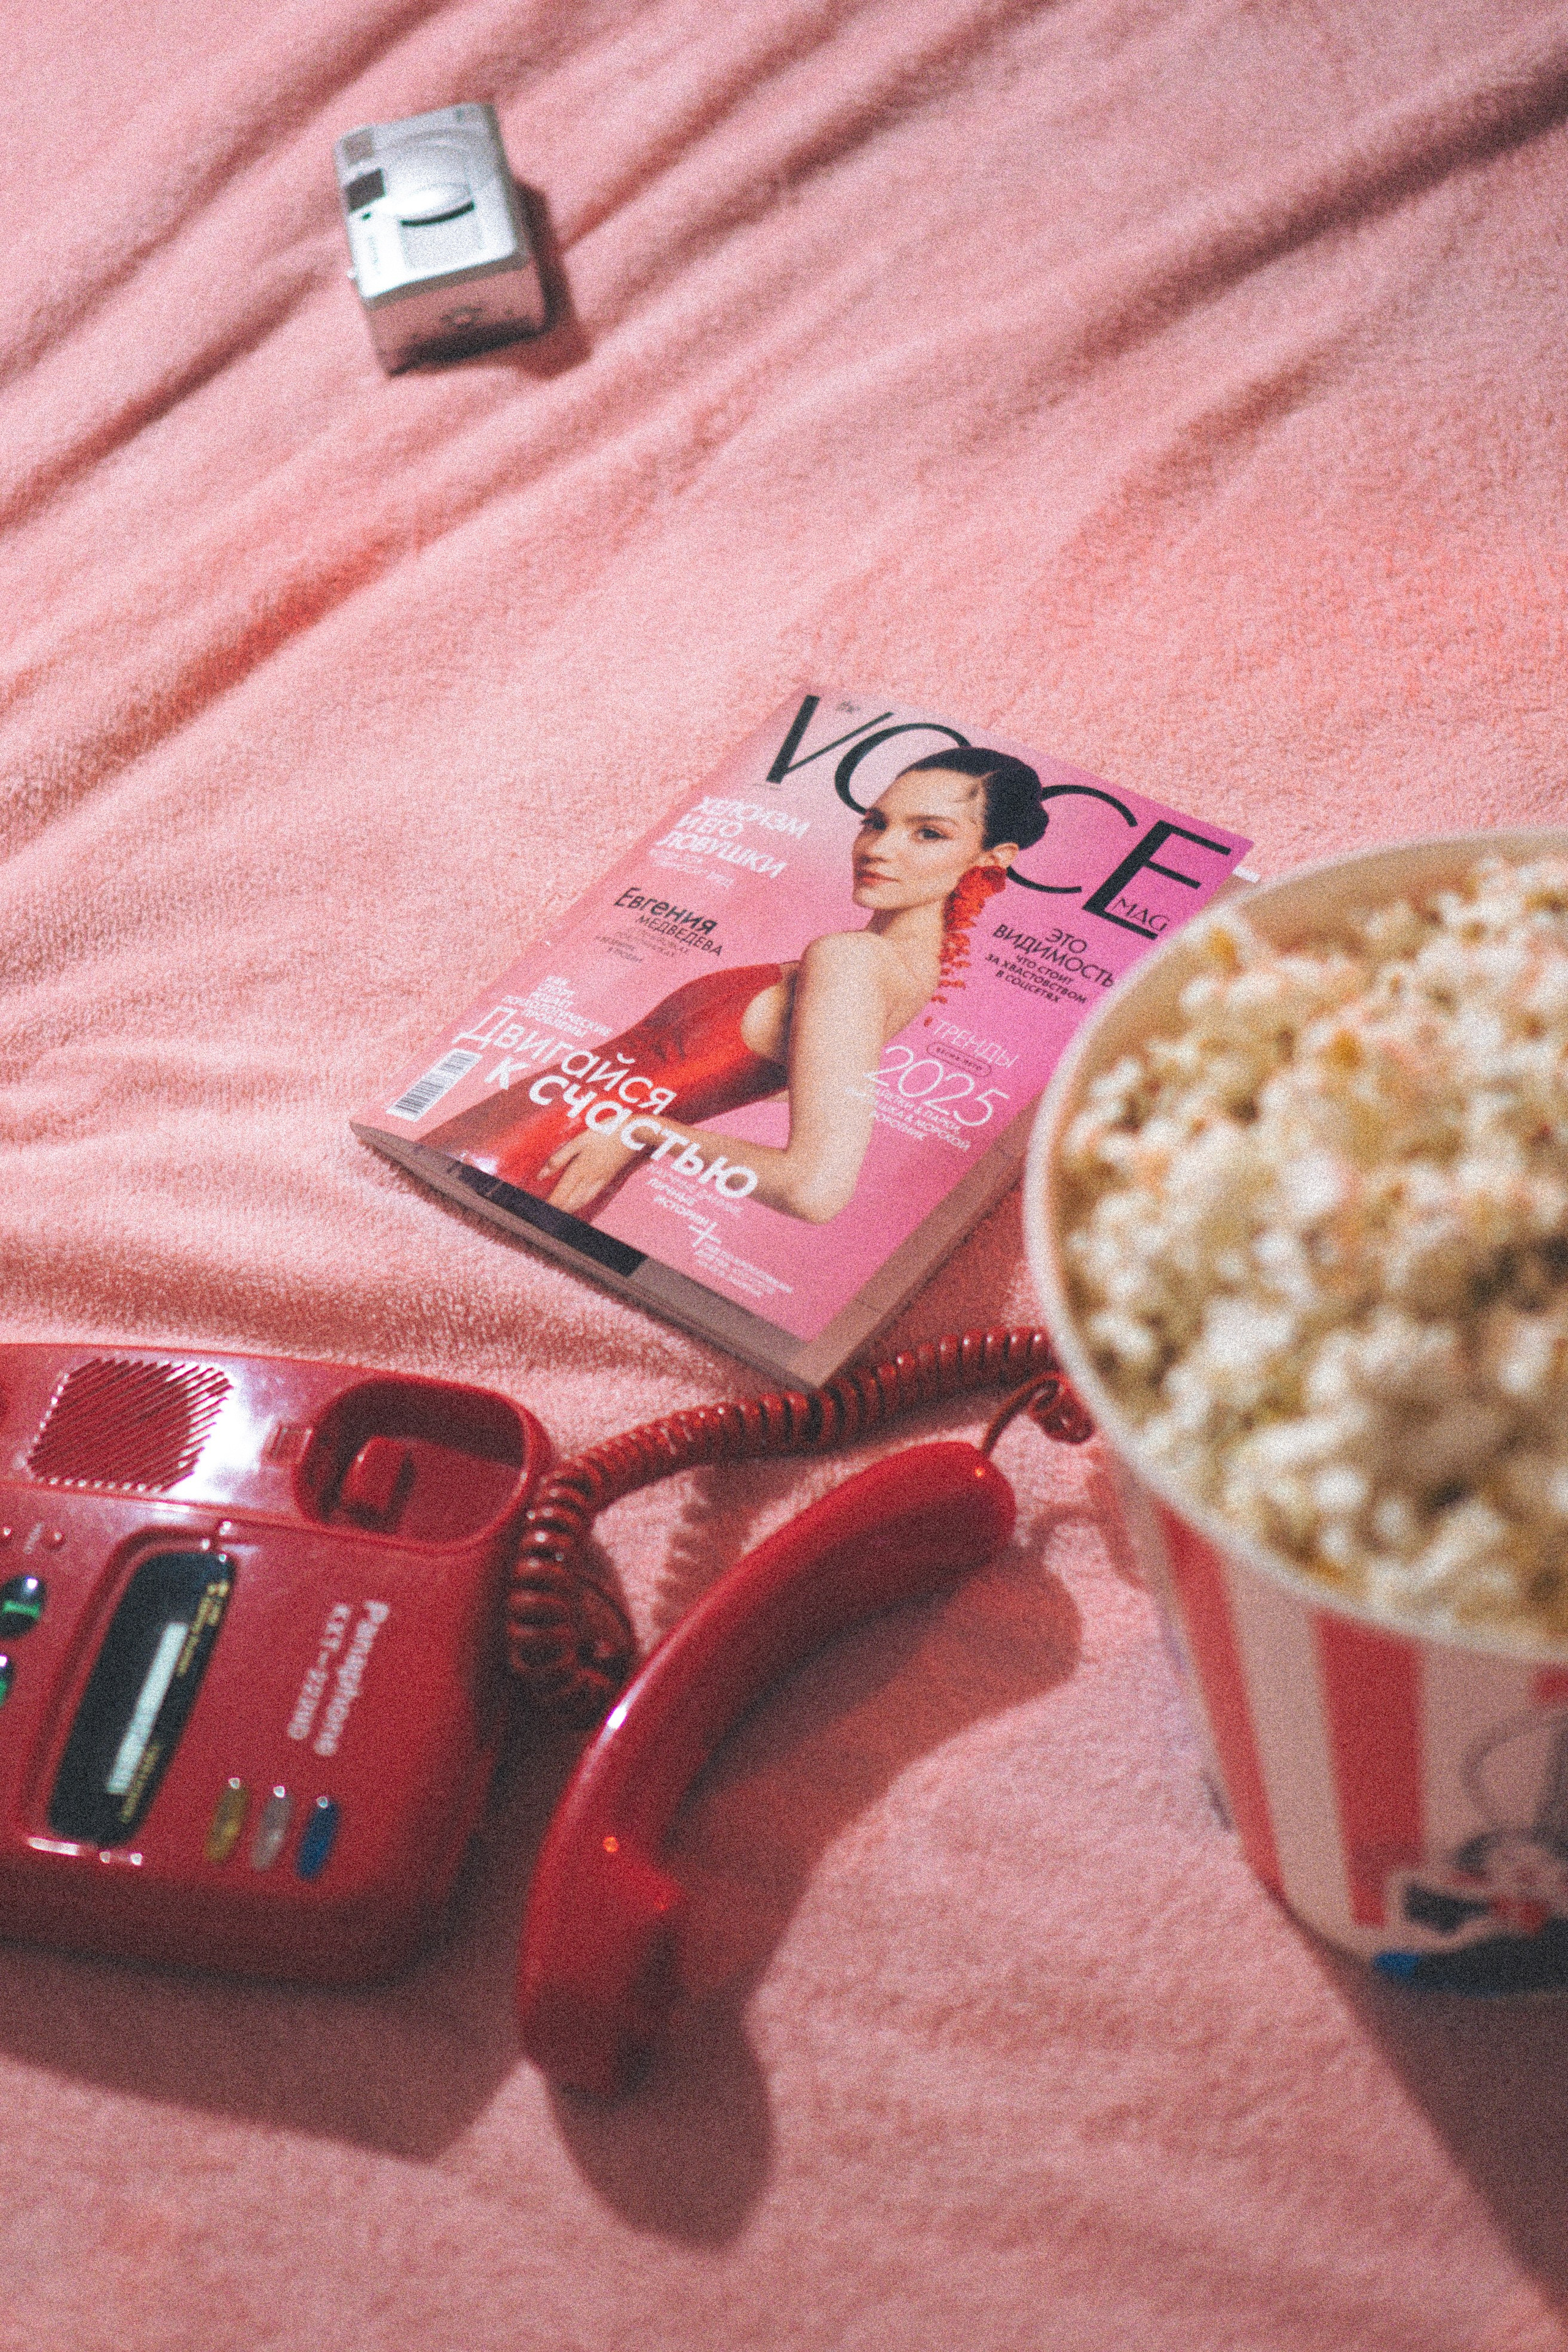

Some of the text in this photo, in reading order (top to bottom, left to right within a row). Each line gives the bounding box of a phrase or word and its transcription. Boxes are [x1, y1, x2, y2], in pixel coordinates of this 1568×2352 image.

[766, 695, 1231, 940] VOCE
[655, 830, 788, 879] ЛОВУШКИ
[613, 886, 718, 935] Евгения
[635, 914, 723, 957] МЕДВЕДЕВА
[992, 923, 1115, 988] ВИДИМОСТЬ
[1044, 927, 1088, 954] ЭТО
[984, 952, 1088, 1005] ЗА ХВАСТОВСТВОМ
[1005, 974, 1061, 1004] СОЦСЕТЯХ
[1015, 954, 1076, 986] ЧТО СТОИТ
[451, 1005, 677, 1115] Двигайся
[932, 1019, 1020, 1069] ТРЕНДЫ
[862, 1045, 1010, 1126] 2025
